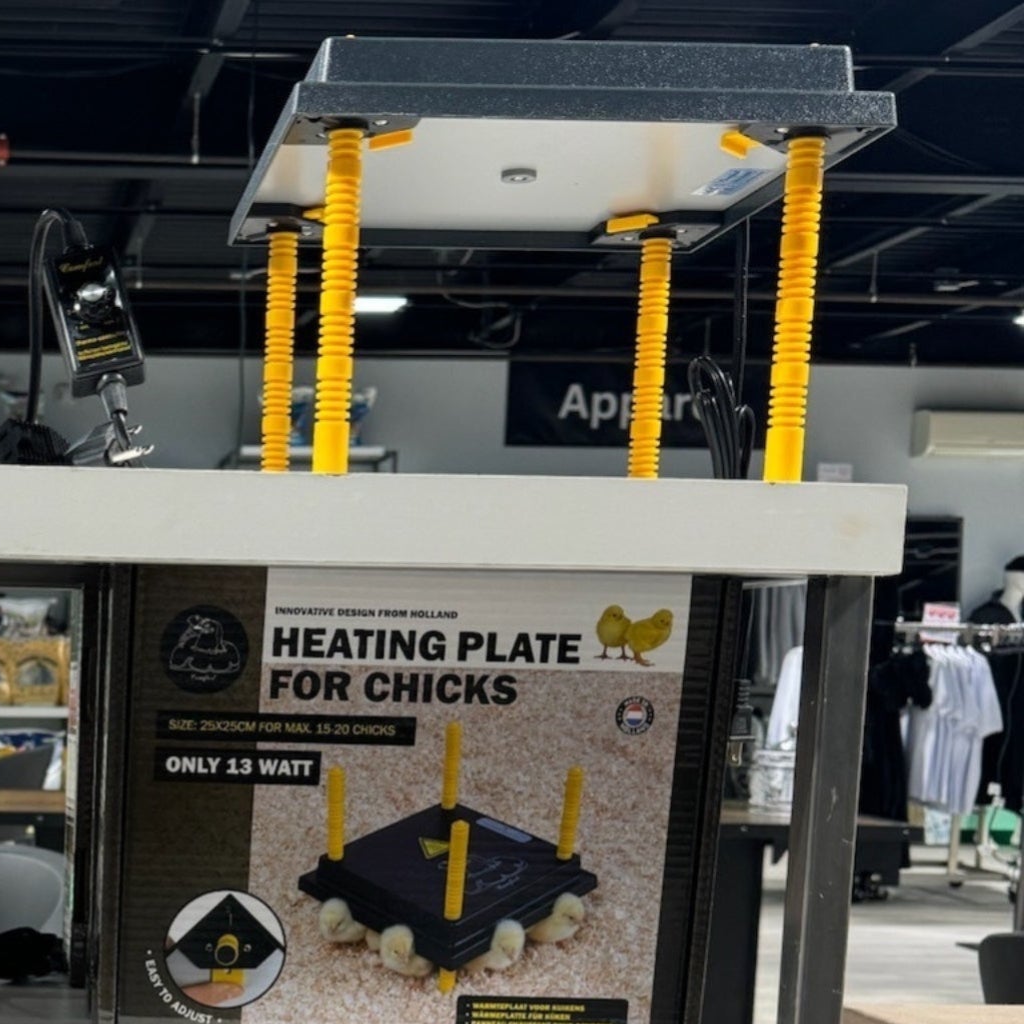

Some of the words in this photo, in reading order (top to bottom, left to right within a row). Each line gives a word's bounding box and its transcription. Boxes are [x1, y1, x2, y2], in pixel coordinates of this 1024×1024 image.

[275, 606, 335, 617] INNOVATIVE
[337, 608, 376, 618] DESIGN
[378, 609, 408, 619] FROM
[410, 609, 459, 620] HOLLAND
[272, 626, 447, 662] HEATING
[457, 630, 582, 664] PLATE
[269, 669, 352, 701] FOR
[364, 671, 519, 706] CHICKS
[168, 718, 197, 731] SIZE:
[200, 719, 257, 733] 25X25CM
[258, 722, 281, 734] FOR
[285, 722, 312, 735] MAX.
[316, 723, 350, 736] 15-20
[352, 724, 397, 737] CHICKS
[165, 755, 222, 774] ONLY
[226, 757, 253, 775] 13
[258, 758, 314, 777] WATT
[145, 959, 164, 988] EASY
[158, 987, 173, 1003] TO
[170, 1001, 214, 1024] ADJUST
